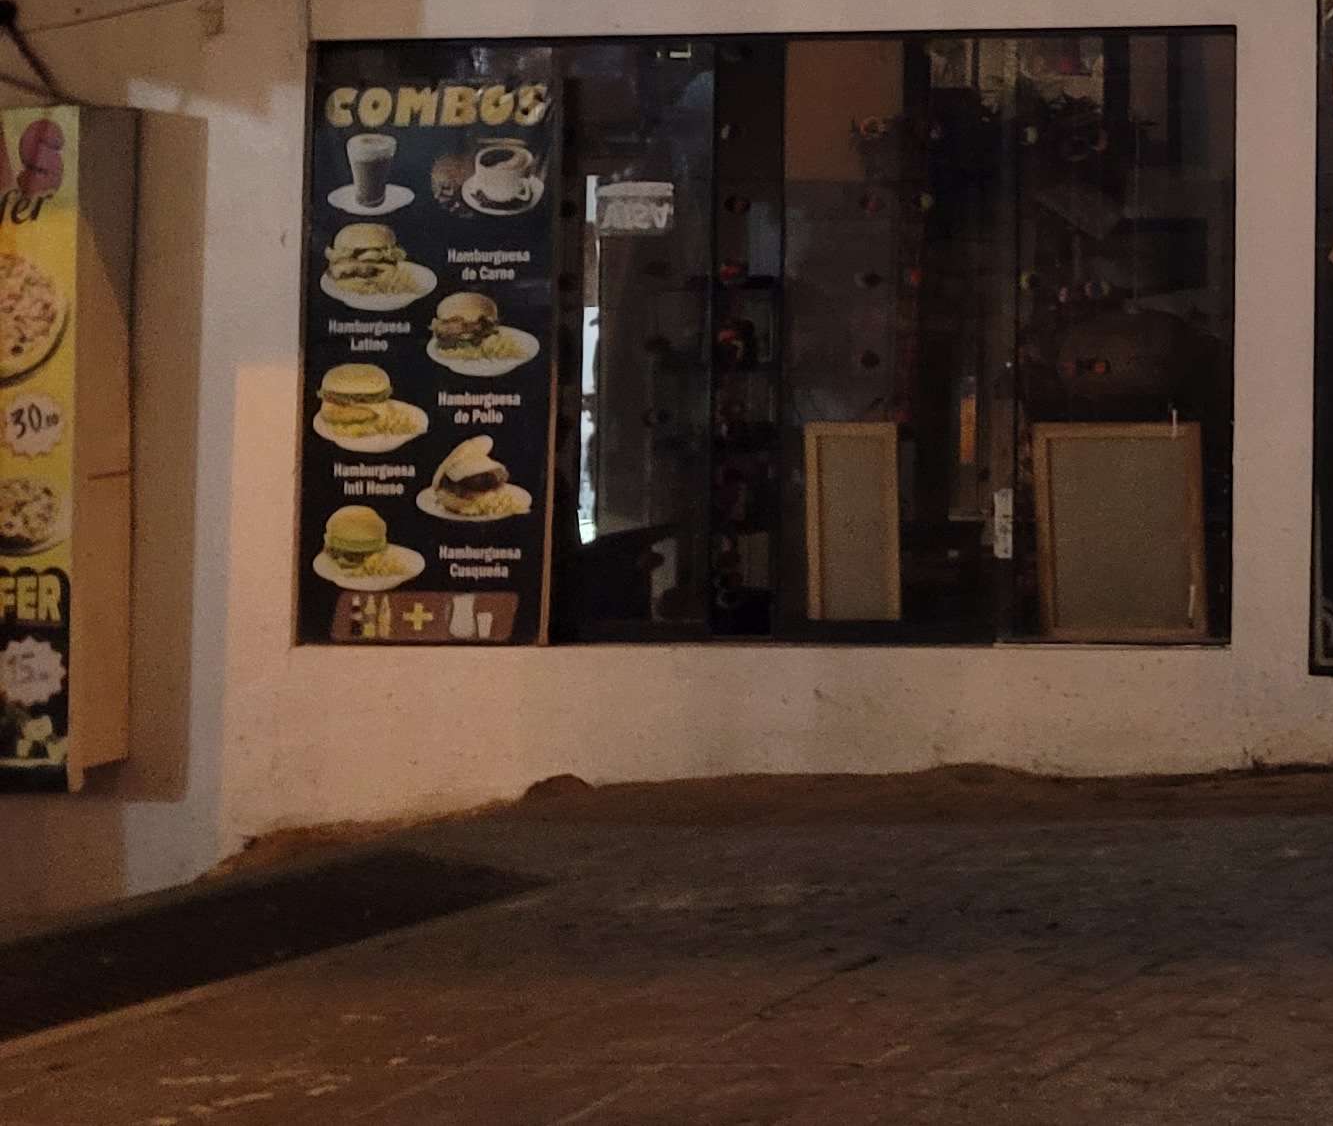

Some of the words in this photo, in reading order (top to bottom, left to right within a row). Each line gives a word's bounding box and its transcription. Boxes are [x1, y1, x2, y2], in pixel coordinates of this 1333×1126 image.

[325, 82, 552, 129] COMBOS
[448, 248, 531, 265] Hamburguesa
[461, 267, 477, 280] de
[479, 266, 516, 281] Carne
[328, 318, 412, 336] Hamburguesa
[350, 337, 389, 351] Latino
[438, 391, 522, 409] Hamburguesa
[454, 410, 470, 424] de
[472, 409, 504, 424] Pollo
[333, 462, 417, 480] Hamburguesa
[366, 481, 405, 496] House
[439, 545, 522, 562] Hamburguesa
[449, 562, 509, 582] Cusqueña
